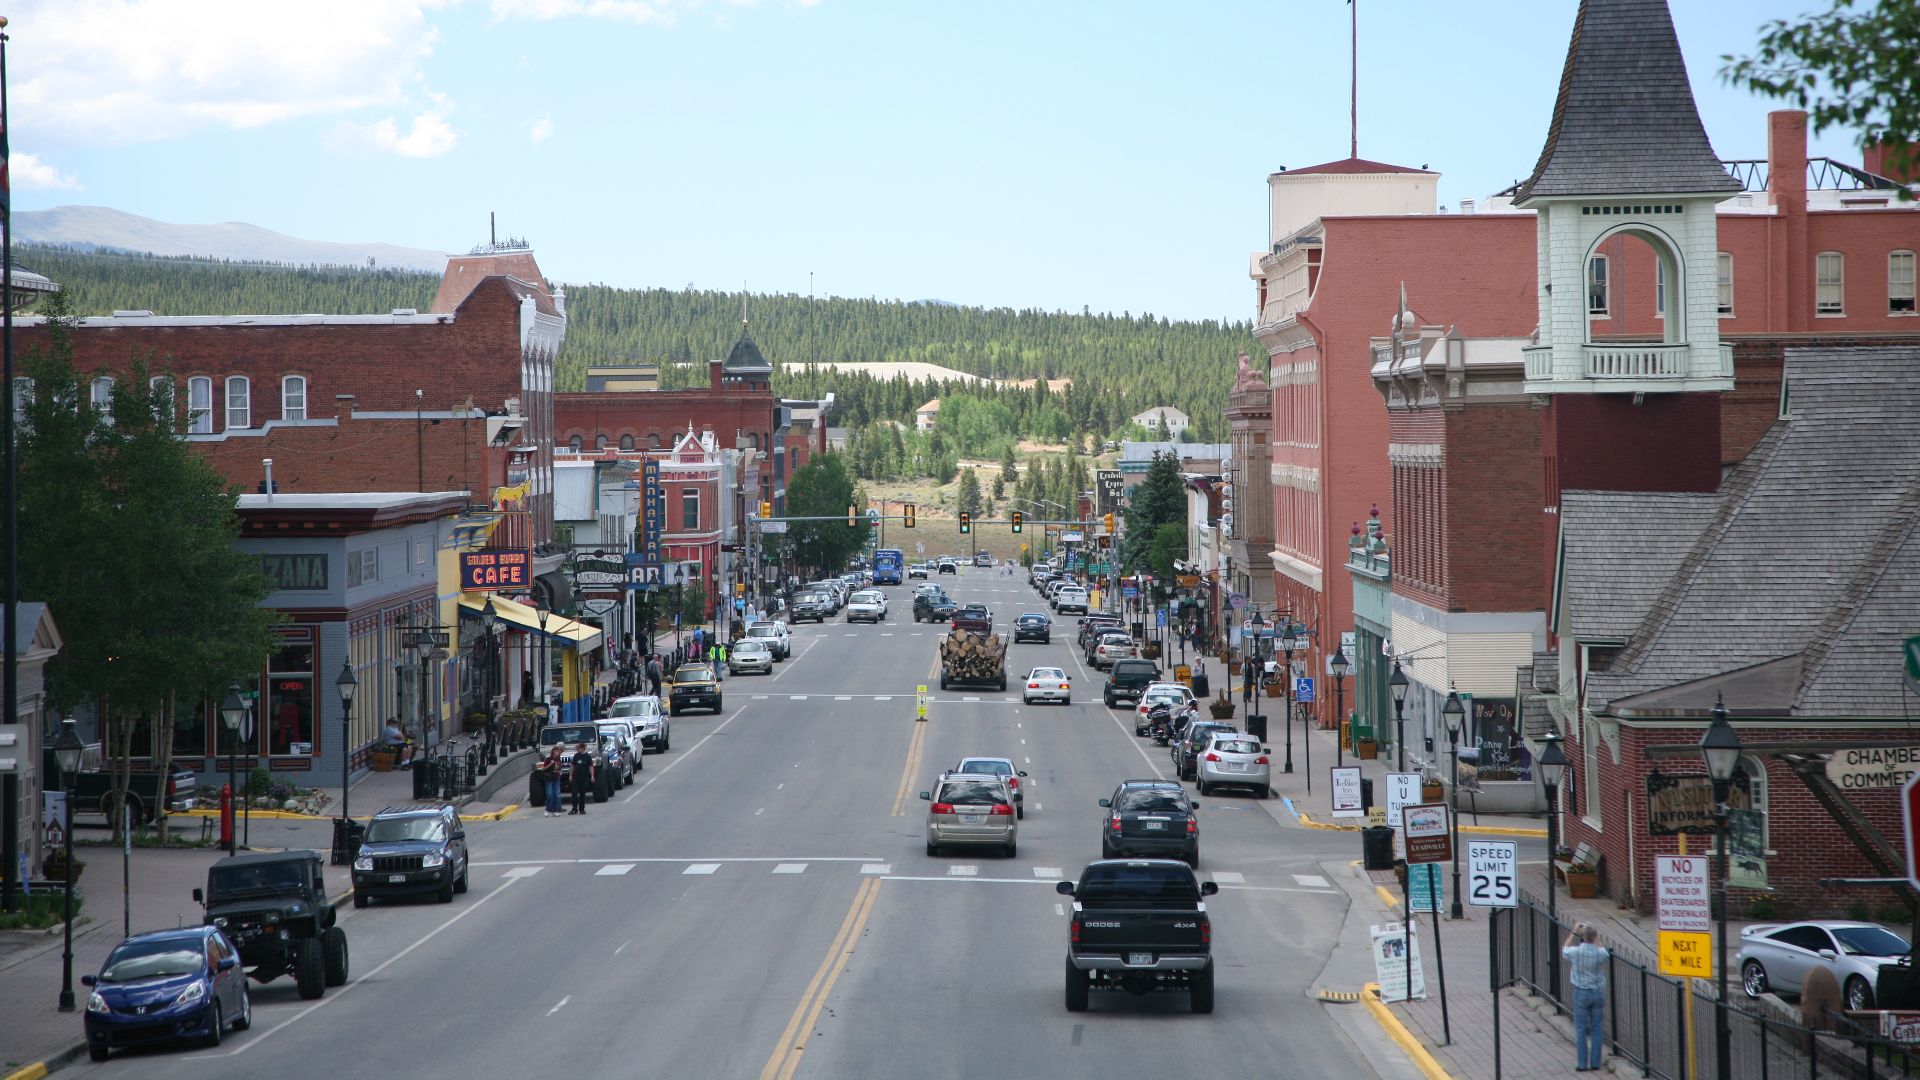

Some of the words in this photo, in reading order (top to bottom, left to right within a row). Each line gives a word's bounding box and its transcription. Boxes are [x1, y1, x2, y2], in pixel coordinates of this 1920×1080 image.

[646, 465, 657, 561] MANHATTAN
[473, 566, 521, 584] CAFE
[281, 682, 305, 690] OPEN
[1885, 763, 1897, 771] OF
[1397, 776, 1409, 785] NO
[1400, 787, 1408, 799] U
[1409, 808, 1442, 819] PRESERVE
[1411, 825, 1443, 833] AMERICA
[1411, 843, 1446, 852] LEADVILLE
[1472, 848, 1512, 859] SPEED
[1476, 862, 1508, 872] LIMIT
[1672, 859, 1692, 874] NO
[1662, 876, 1692, 884] BICYCLES
[1693, 876, 1703, 884] OR
[1473, 875, 1512, 900] 25
[1665, 887, 1690, 895] INLINES
[1691, 887, 1701, 895] OR
[1661, 898, 1706, 906] SKATEBOARDS
[1661, 909, 1670, 917] ON
[1672, 909, 1708, 918] SIDEWALKS
[1673, 940, 1697, 952] NEXT
[1680, 956, 1702, 968] MILE
